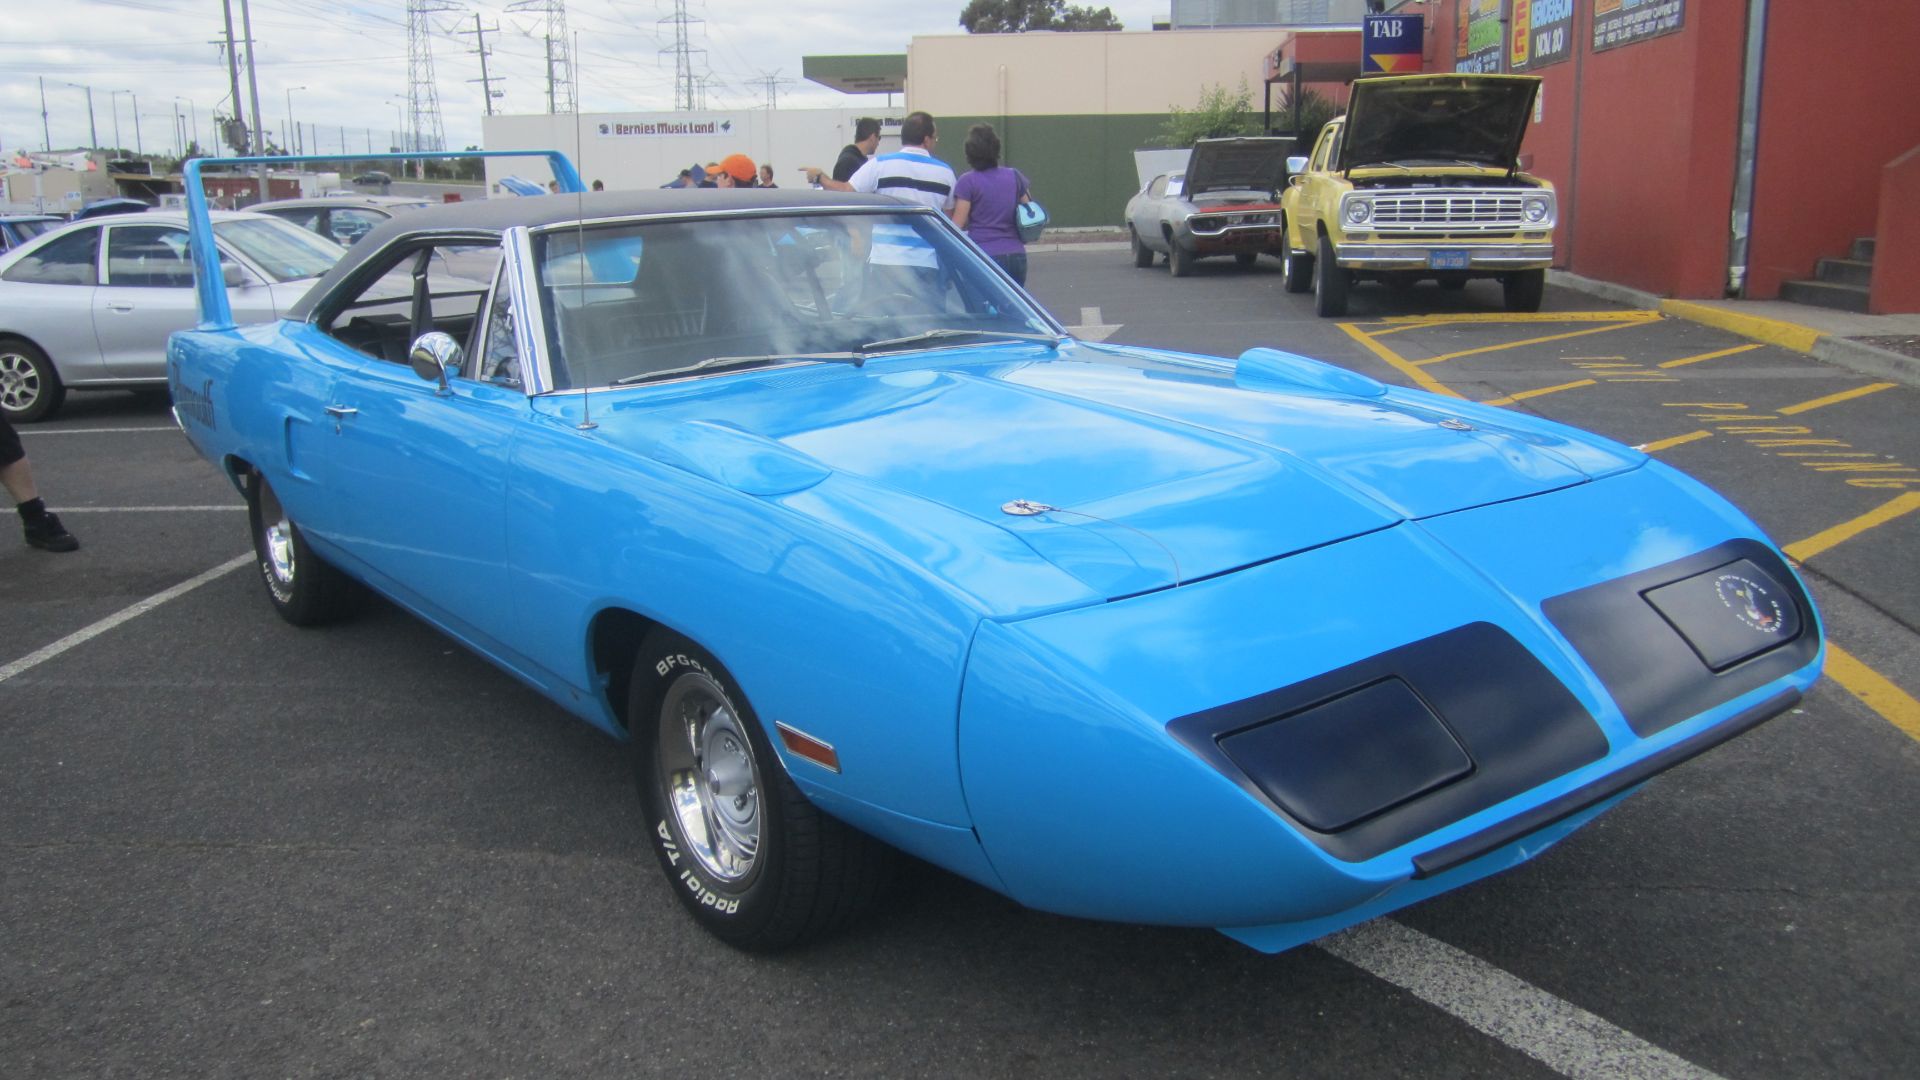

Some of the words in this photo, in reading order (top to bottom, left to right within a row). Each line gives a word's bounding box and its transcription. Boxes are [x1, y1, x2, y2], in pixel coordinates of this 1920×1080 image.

[1370, 20, 1402, 38] TAB
[615, 123, 656, 135] Bernies
[657, 122, 687, 134] Music
[689, 121, 714, 134] Land
[657, 820, 680, 867] T/A
[680, 870, 739, 914] Radial
